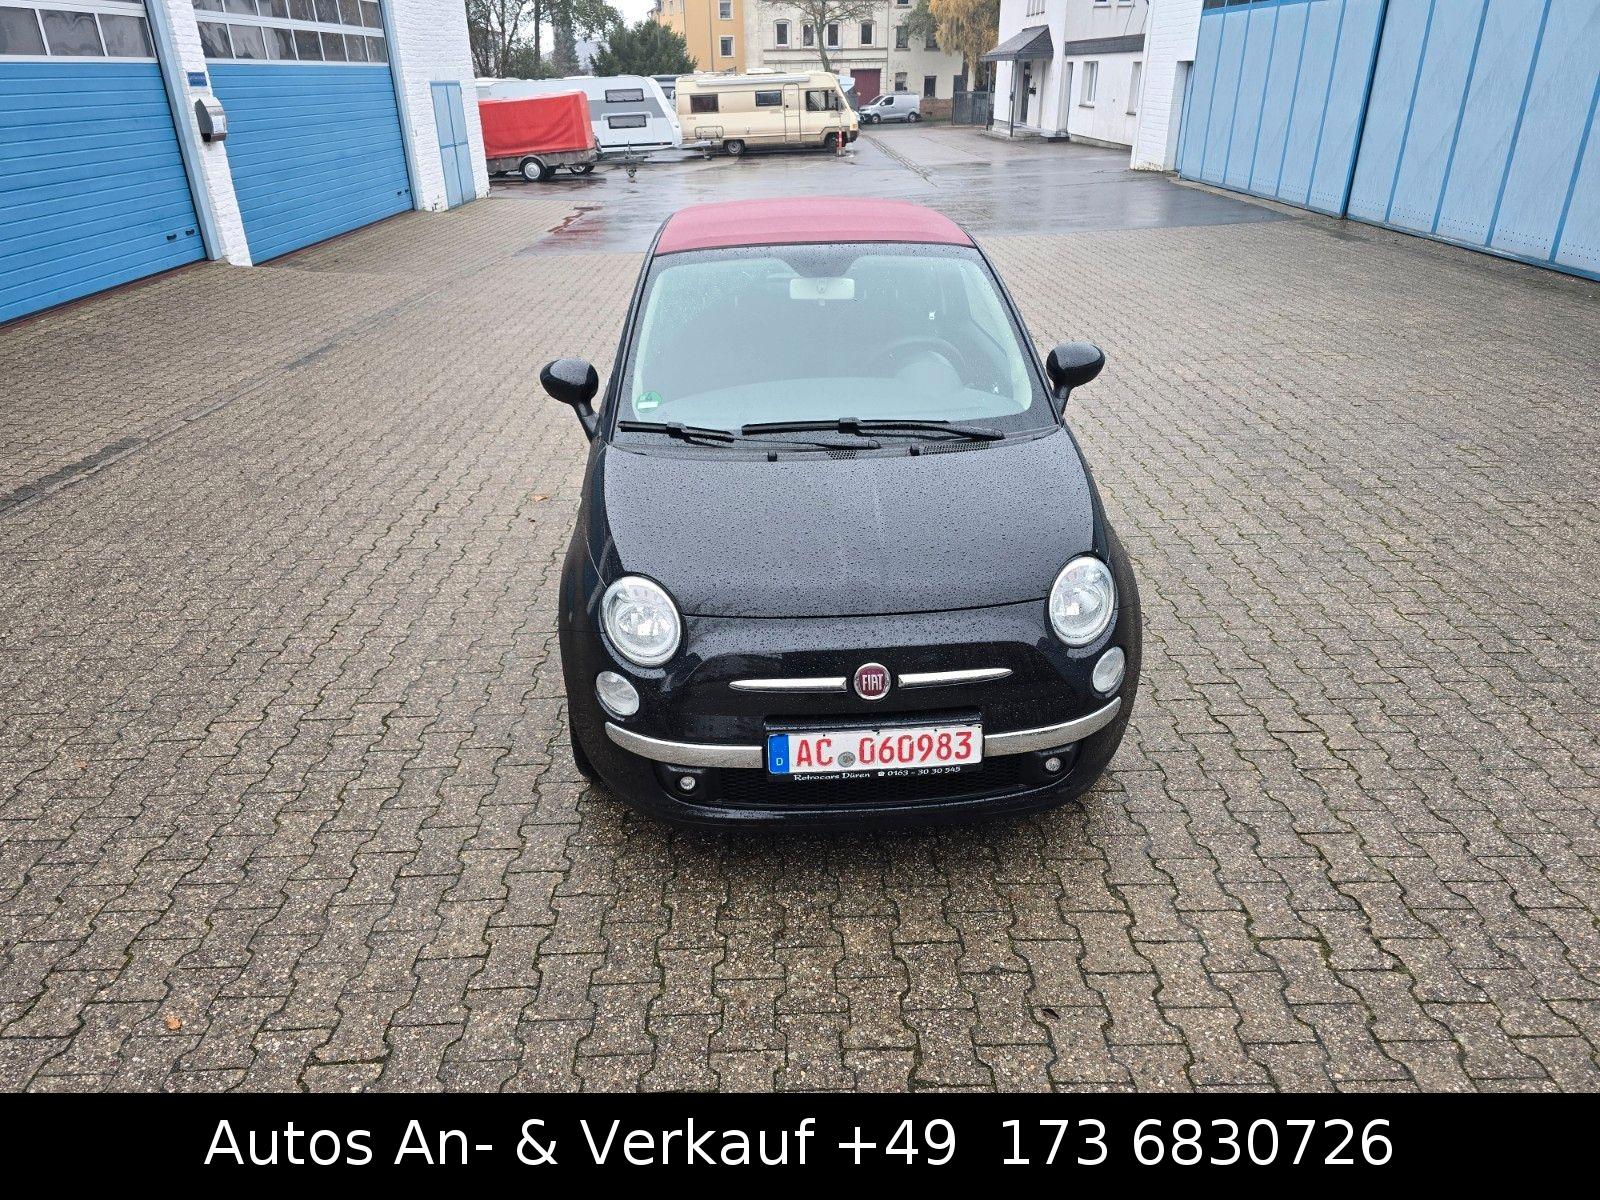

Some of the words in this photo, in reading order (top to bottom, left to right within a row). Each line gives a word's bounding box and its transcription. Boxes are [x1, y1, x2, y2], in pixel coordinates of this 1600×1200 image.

[862, 673, 884, 691] FIAT
[797, 739, 832, 767] AC
[859, 731, 972, 764] 060983
[775, 757, 784, 766] D
[793, 773, 840, 782] Retrocars
[842, 771, 870, 779] Düren
[887, 769, 909, 777] 0163
[917, 768, 929, 776] 30
[930, 767, 943, 775] 30
[944, 766, 961, 774] 545
